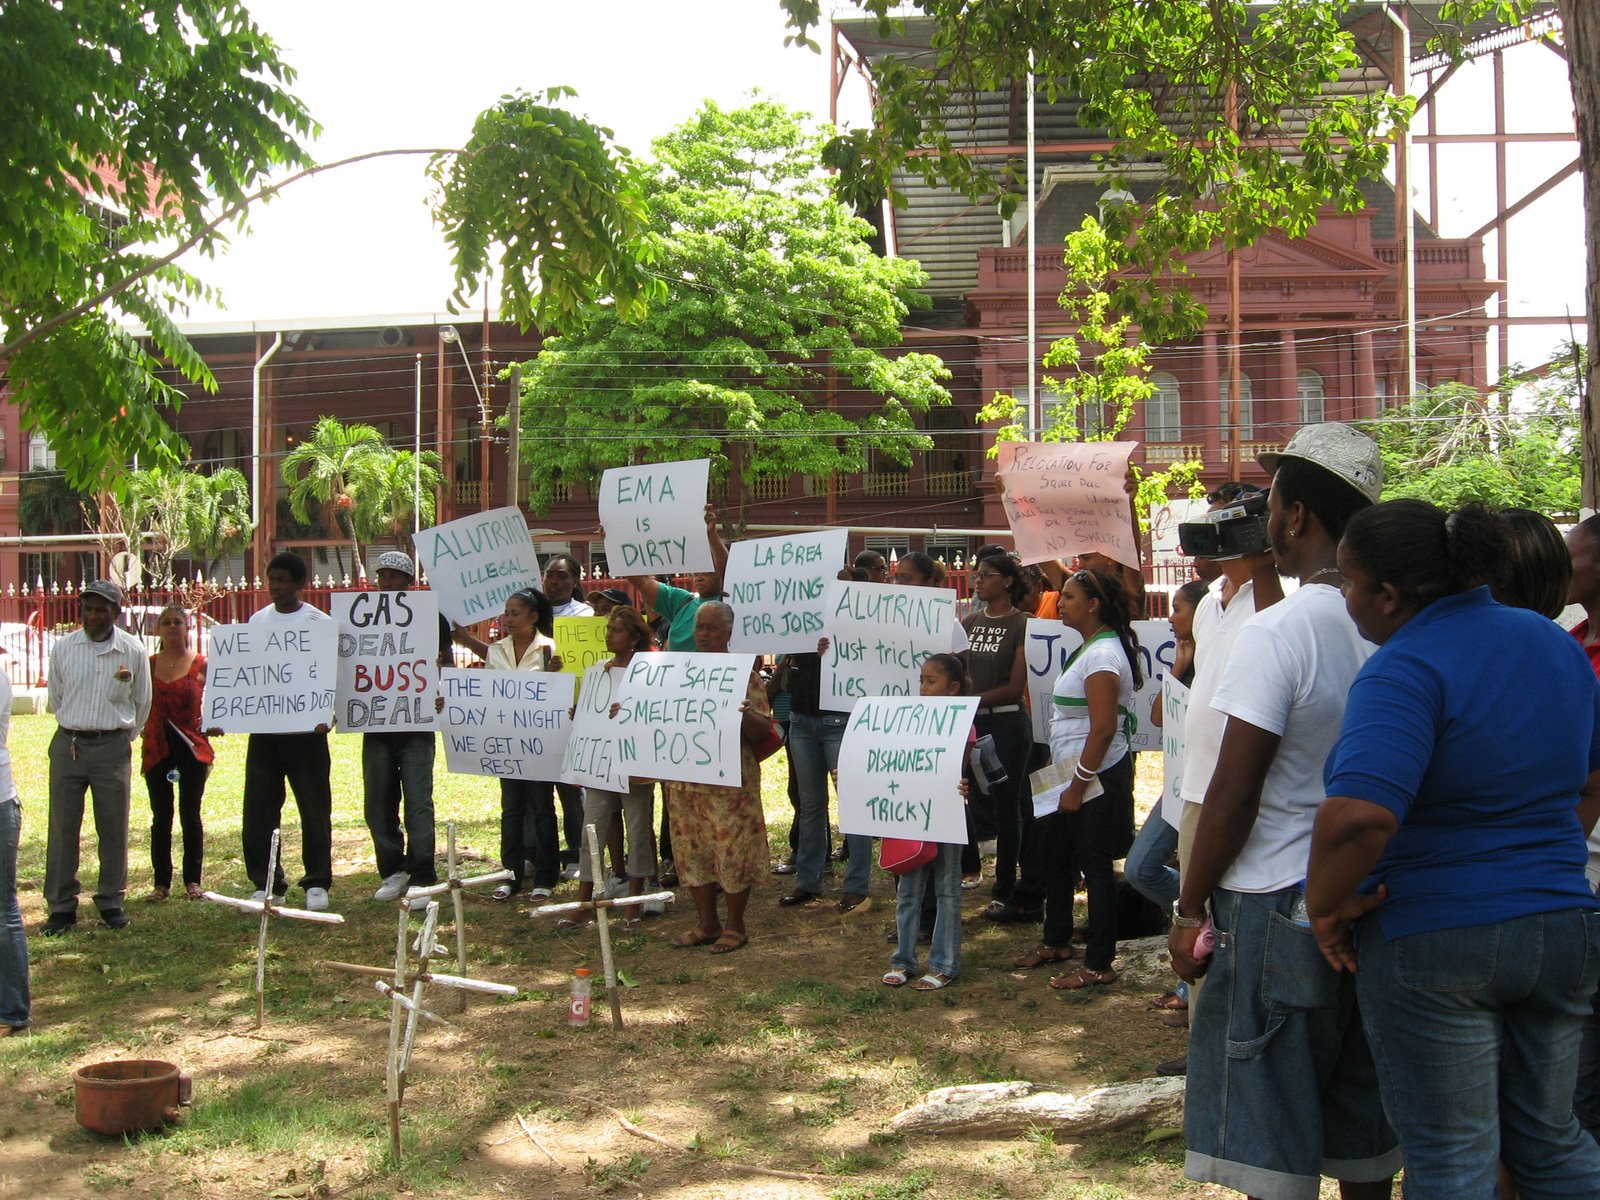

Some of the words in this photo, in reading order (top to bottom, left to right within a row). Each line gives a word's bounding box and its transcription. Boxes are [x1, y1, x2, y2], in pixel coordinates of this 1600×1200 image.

[618, 475, 675, 504] EMA
[636, 517, 650, 532] IS
[621, 536, 686, 567] DIRTY
[754, 543, 775, 567] LA
[781, 542, 822, 566] BREA
[1046, 536, 1067, 553] NO
[461, 556, 529, 588] ILLEGAL
[732, 580, 765, 604] NOT
[775, 576, 824, 605] DYING
[349, 591, 413, 628] GAS
[835, 586, 952, 635] ALUTRINT
[555, 624, 588, 644] THE
[743, 613, 775, 636] FOR
[780, 611, 824, 636] JOBS
[972, 626, 986, 634] IT'S
[988, 627, 1007, 635] NOT
[213, 632, 251, 656] WE
[264, 630, 312, 652] ARE
[338, 632, 414, 658] DEAL
[969, 634, 1003, 643] EASY
[562, 650, 577, 664] IS
[212, 663, 293, 688] EATING
[308, 661, 318, 680] &
[354, 659, 427, 693] BUSS
[629, 661, 674, 687] PUT
[832, 672, 866, 697] lies
[444, 677, 482, 697] THE
[492, 679, 547, 701] NOISE
[211, 694, 306, 720] BREATHING
[309, 688, 337, 712] DUST
[347, 695, 434, 728] DEAL
[449, 706, 486, 726] DAY
[497, 710, 506, 723] +
[514, 709, 565, 729] NIGHT
[853, 703, 967, 736] ALUTRINT
[451, 735, 477, 753] WE
[484, 737, 513, 755] GET
[520, 737, 543, 755] NO
[618, 735, 637, 763] IN
[480, 757, 523, 775] REST
[867, 748, 946, 775] DISHONEST
[888, 780, 899, 795] +
[866, 796, 931, 832] TRICKY
[572, 1001, 583, 1015] G
